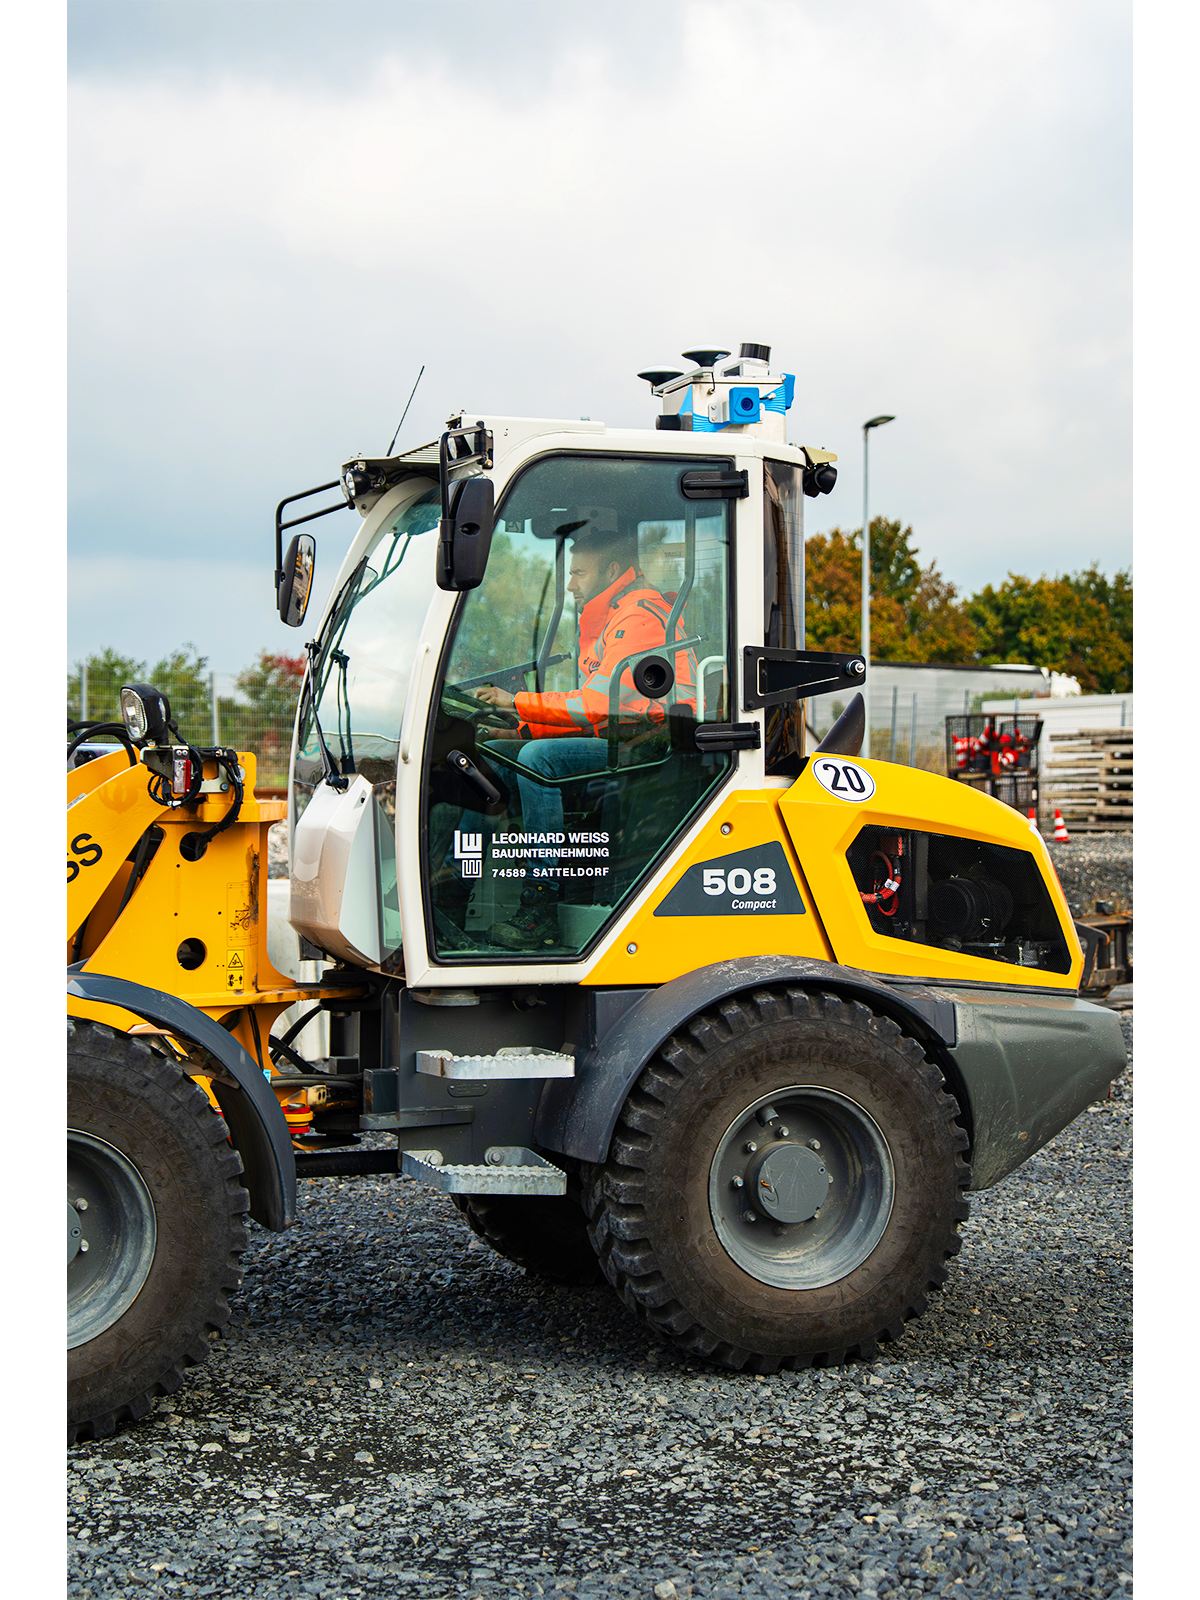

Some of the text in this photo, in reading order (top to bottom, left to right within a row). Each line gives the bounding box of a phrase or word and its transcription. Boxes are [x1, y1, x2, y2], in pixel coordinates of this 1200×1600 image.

[822, 763, 866, 793] 20
[491, 831, 610, 844] LEONHARD WEISS
[491, 847, 610, 859] BAUUNTERNEHMUNG
[491, 867, 610, 878] 74589 SATTELDORF
[702, 867, 777, 896] 508
[731, 898, 777, 911] Compact
